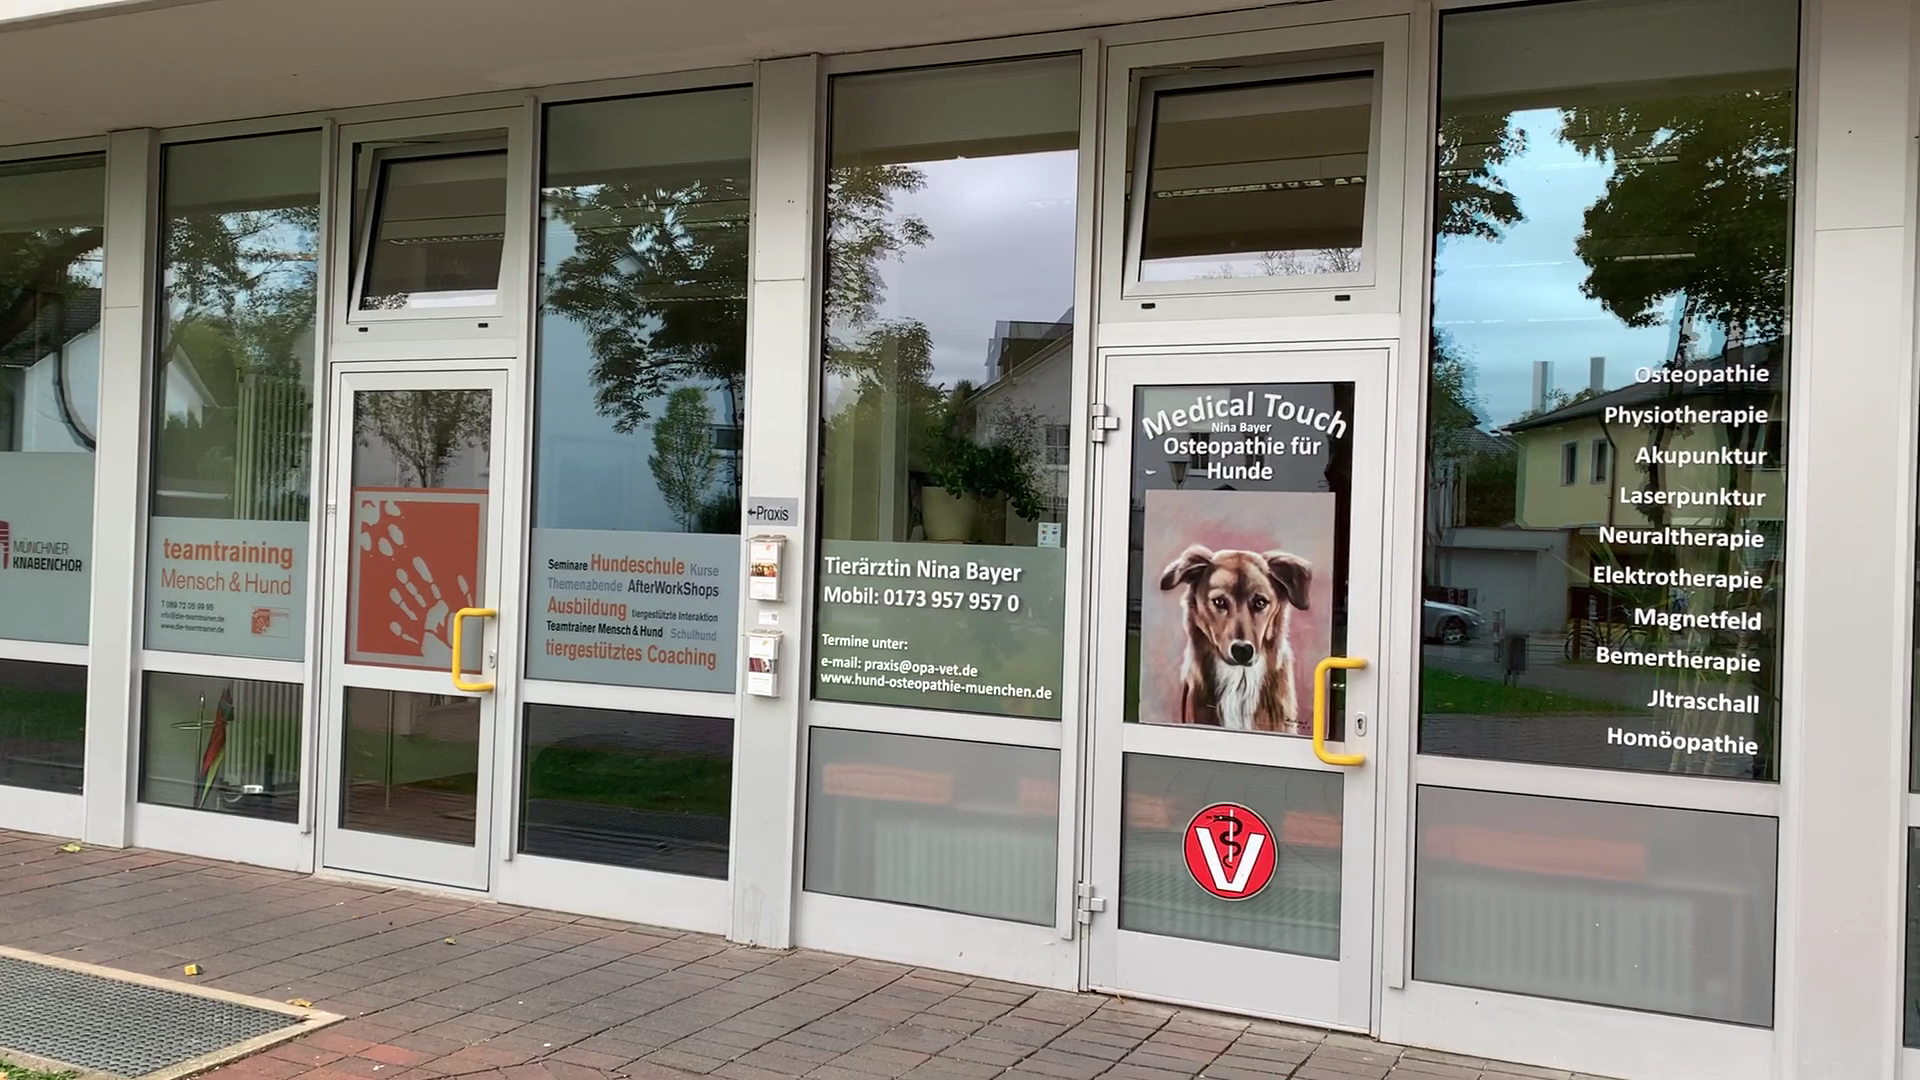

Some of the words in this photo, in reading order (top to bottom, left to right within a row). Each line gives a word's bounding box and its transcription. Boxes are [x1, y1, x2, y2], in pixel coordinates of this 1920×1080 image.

[1634, 364, 1770, 386] Osteopathie
[1141, 391, 1254, 440] Medical
[1264, 393, 1347, 439] Touch
[1604, 405, 1769, 428] Physiotherapie
[1211, 422, 1237, 433] Nina
[1239, 422, 1272, 434] Bayer
[1163, 437, 1285, 459] Osteopathie
[1290, 437, 1322, 455] für
[1635, 446, 1768, 468] Akupunktur
[1207, 462, 1273, 480] Hunde
[1620, 487, 1767, 508] Laserpunktur
[756, 505, 789, 521] Praxis
[13, 537, 69, 555] MÜNCHNER
[1599, 526, 1765, 551] Neuraltherapie
[12, 556, 82, 572] KNABENCHOR
[163, 538, 294, 570] teamtraining
[548, 559, 588, 571] Seminare
[591, 554, 685, 575] Hundeschule
[690, 563, 719, 577] Kurse
[160, 568, 225, 592] Mensch
[229, 572, 241, 592] &
[244, 573, 292, 596] Hund
[825, 556, 911, 578] Tierärztin
[917, 560, 960, 580] Nina
[966, 562, 1022, 586] Bayer
[1593, 566, 1763, 592] Elektrotherapie
[548, 577, 623, 592] Themenabende
[627, 579, 719, 599] AfterWorkShops
[823, 586, 879, 605] Mobil:
[883, 588, 927, 607] 0173
[931, 590, 964, 609] 957
[968, 592, 1002, 611] 957
[1007, 594, 1020, 613] 0
[547, 596, 627, 621] Ausbildung
[631, 609, 677, 621] tiergestützte
[678, 610, 718, 622] Interaktion
[1634, 607, 1762, 631] Magnetfeld
[546, 620, 596, 634] Teamtrainer
[598, 623, 632, 636] Mensch
[632, 626, 639, 635] &
[640, 626, 663, 638] Hund
[670, 628, 717, 641] Schulhund
[822, 633, 869, 648] Termine
[872, 636, 908, 650] unter:
[545, 639, 642, 661] tiergestütztes
[647, 644, 717, 671] Coaching
[821, 656, 861, 669] e-mail:
[864, 659, 978, 677] praxis@opa-vet.de
[1596, 646, 1761, 674] Bemertherapie
[820, 673, 1052, 699] www.hund-osteopathie-muenchen.de
[1607, 727, 1758, 755] Homöopathie
